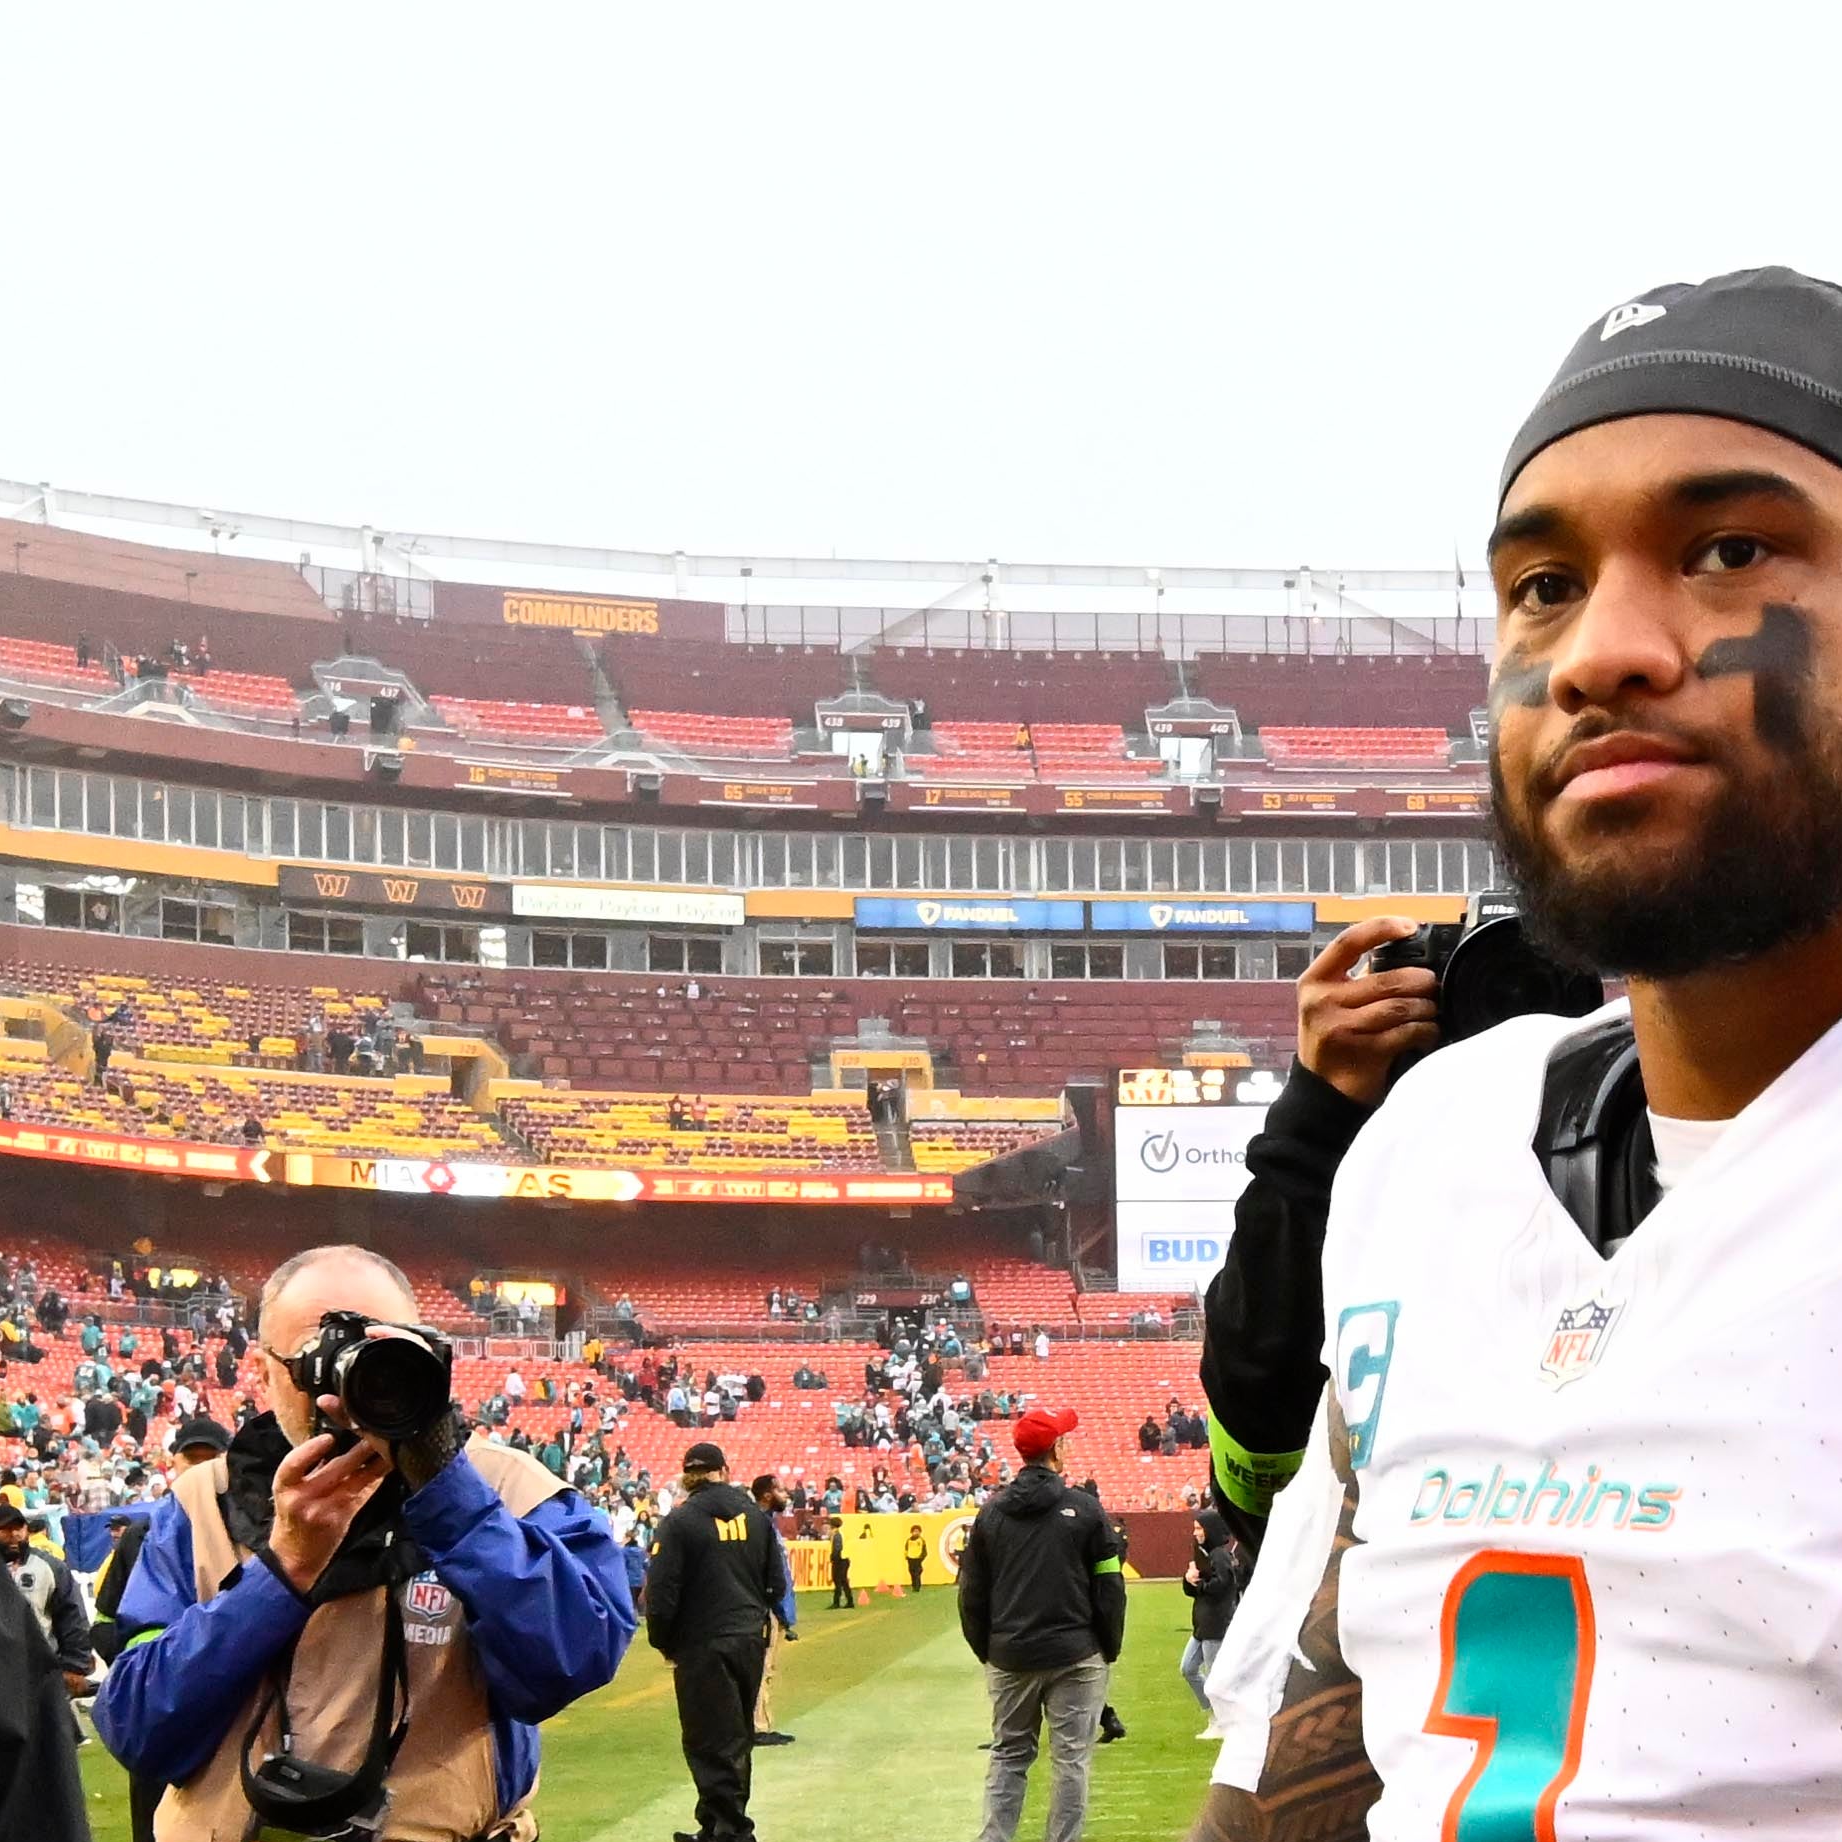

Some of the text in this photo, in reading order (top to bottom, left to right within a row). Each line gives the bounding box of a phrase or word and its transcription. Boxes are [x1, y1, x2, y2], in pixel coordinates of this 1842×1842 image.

[503, 599, 658, 634] COMMANDERS
[724, 784, 742, 800] 65
[1064, 792, 1083, 807] 55
[1262, 794, 1281, 809] 53
[944, 907, 1019, 923] FANDUEL
[1176, 909, 1249, 925] FANDUEL
[1482, 904, 1518, 915] Niko
[351, 1161, 415, 1184] MIA
[1149, 1240, 1219, 1262] BUD
[1546, 1333, 1591, 1368] NFL
[1409, 1462, 1684, 1534] Dolphins
